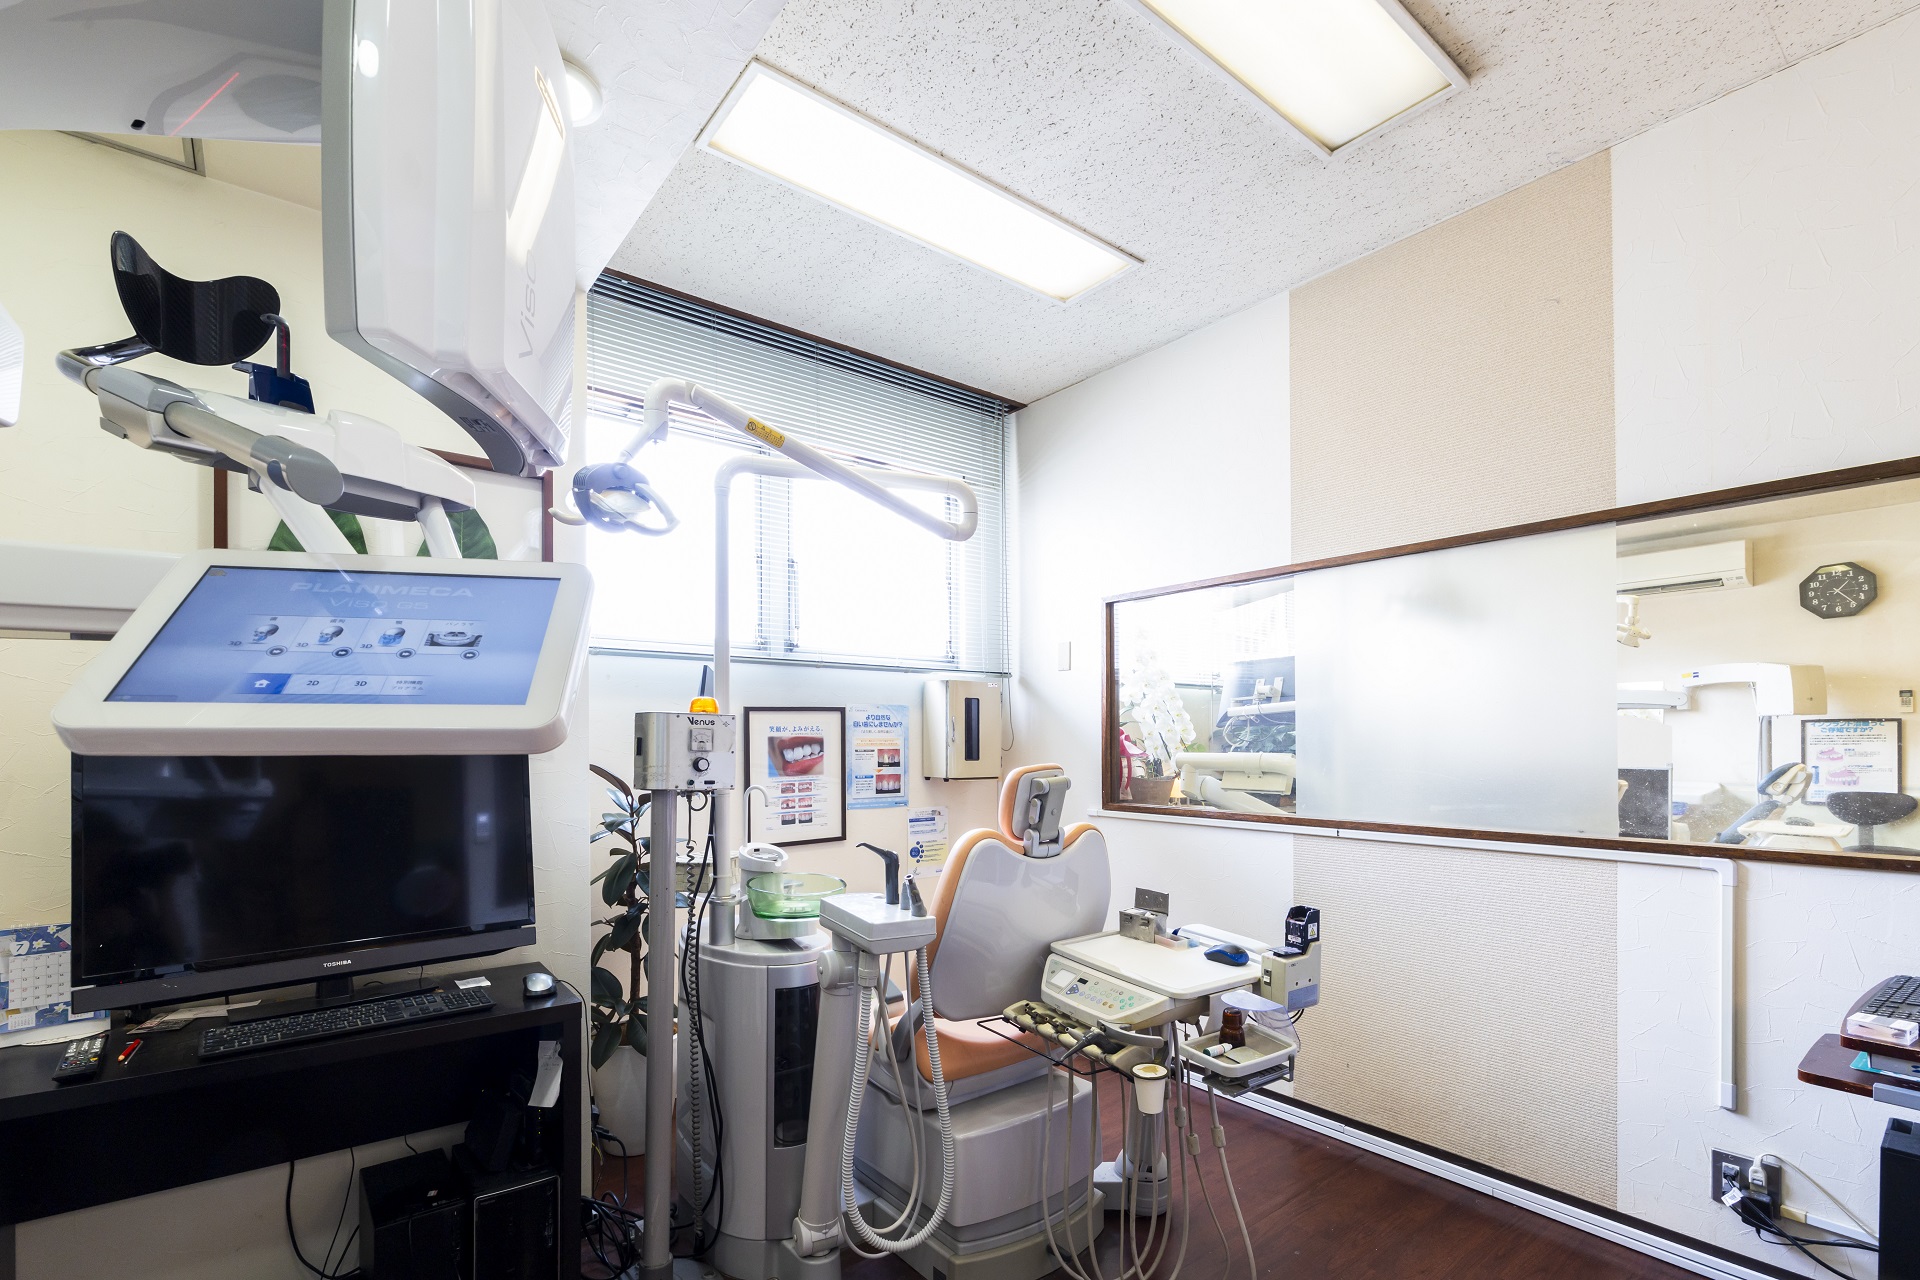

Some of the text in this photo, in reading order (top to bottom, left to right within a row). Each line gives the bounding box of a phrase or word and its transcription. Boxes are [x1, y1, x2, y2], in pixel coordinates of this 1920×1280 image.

[290, 582, 474, 598] PLANMECA
[396, 601, 430, 610] G5
[687, 716, 716, 726] Venus
[768, 725, 824, 733] 笑顔が、よみがえる。
[16, 943, 24, 952] 7
[322, 959, 352, 968] TOSHIBA
